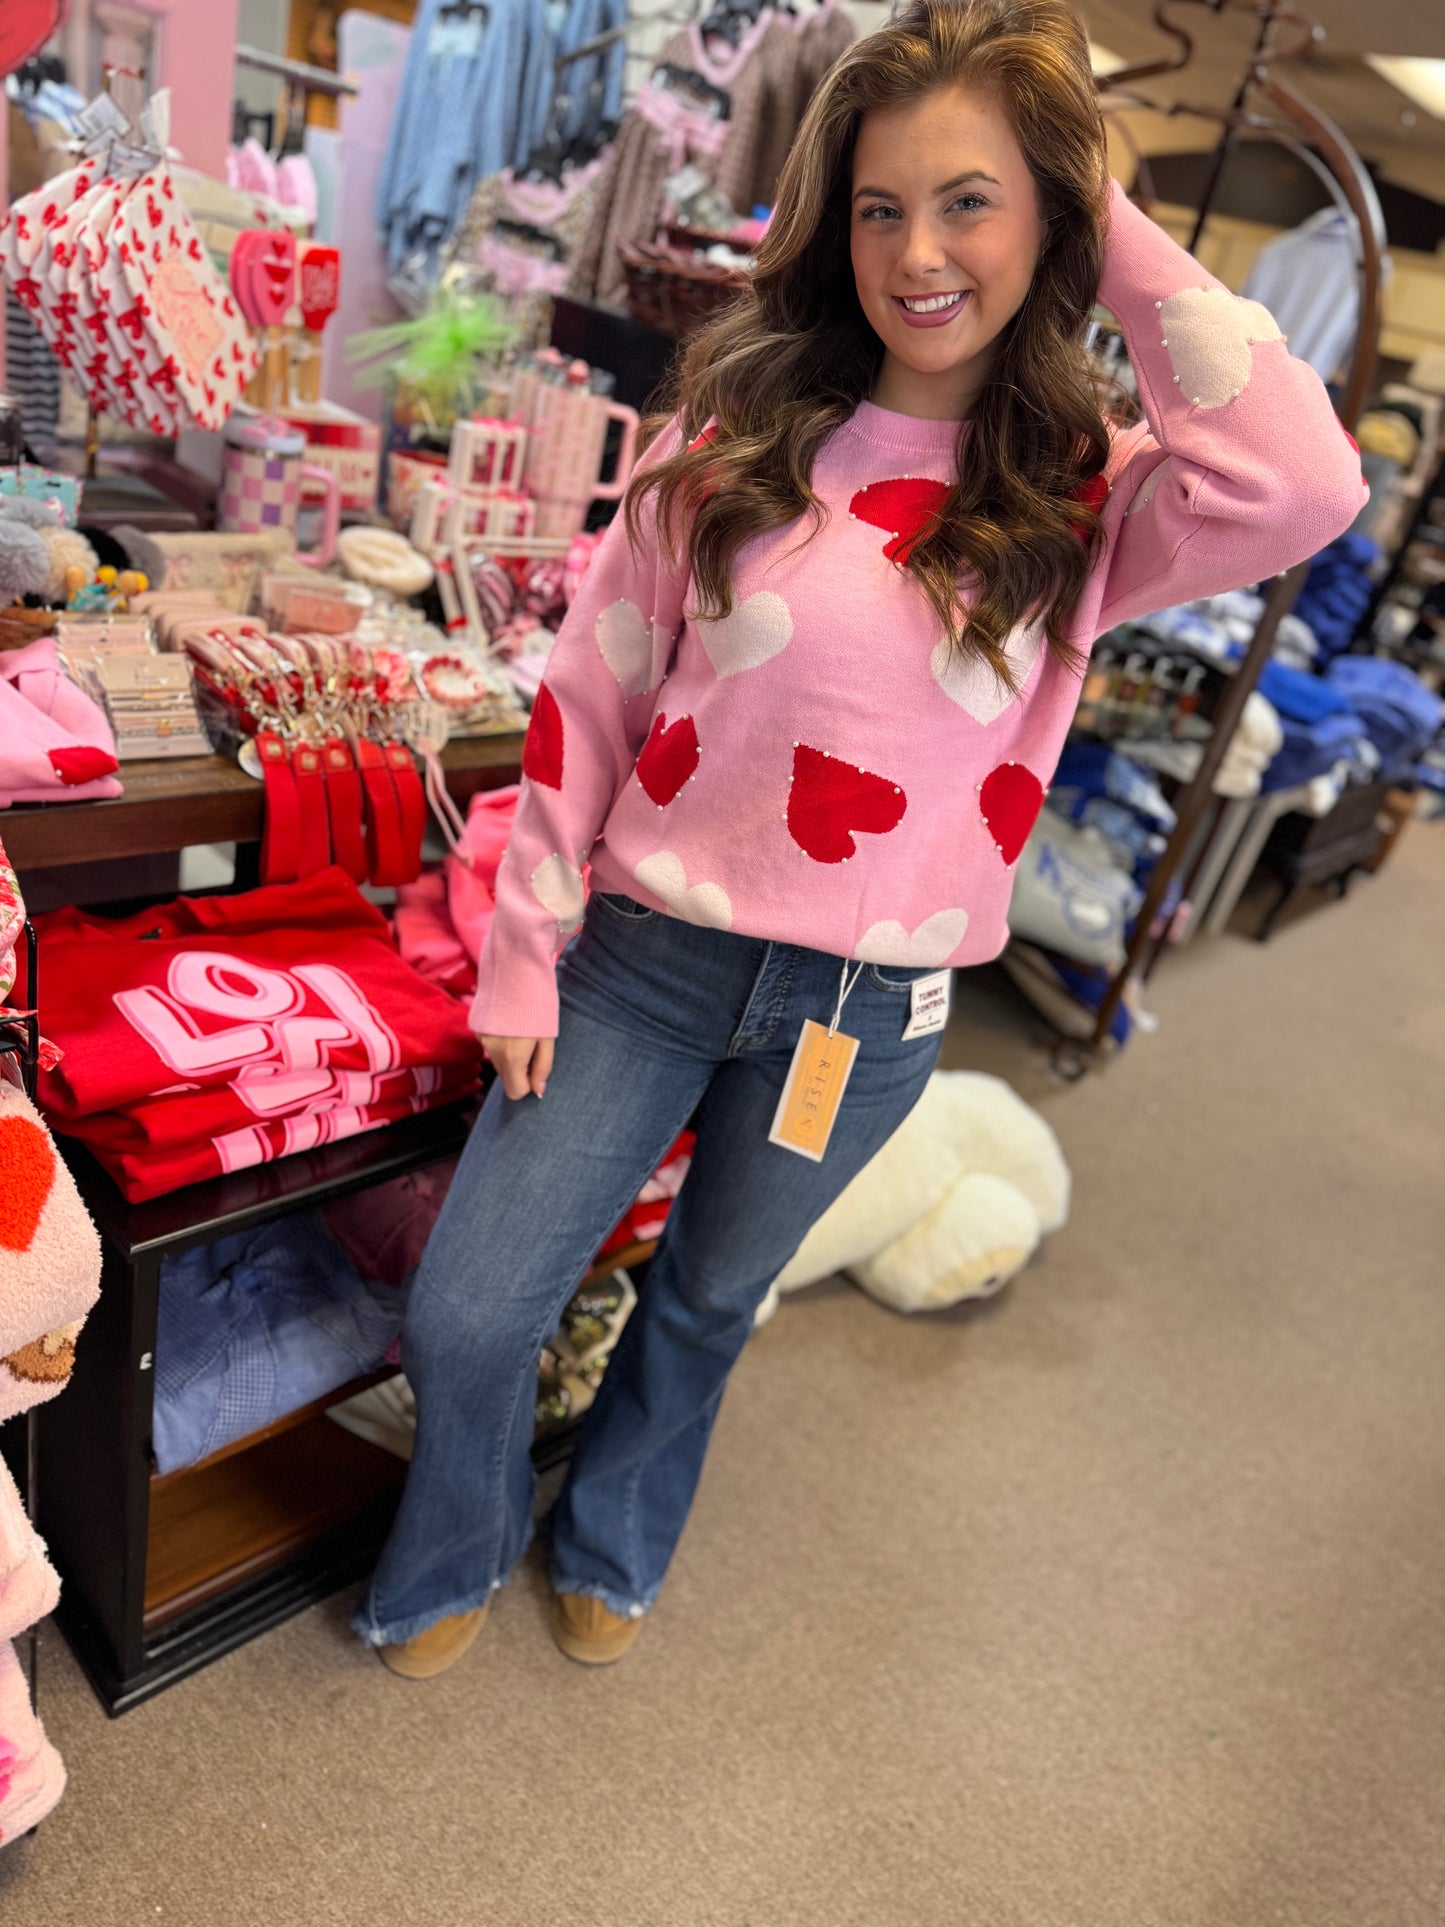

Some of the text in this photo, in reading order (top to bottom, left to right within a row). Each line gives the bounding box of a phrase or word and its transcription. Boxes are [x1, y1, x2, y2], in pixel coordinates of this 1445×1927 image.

[918, 986, 944, 1002] TUMMY
[915, 997, 946, 1015] CONTROL
[799, 1059, 831, 1131] RISEN
